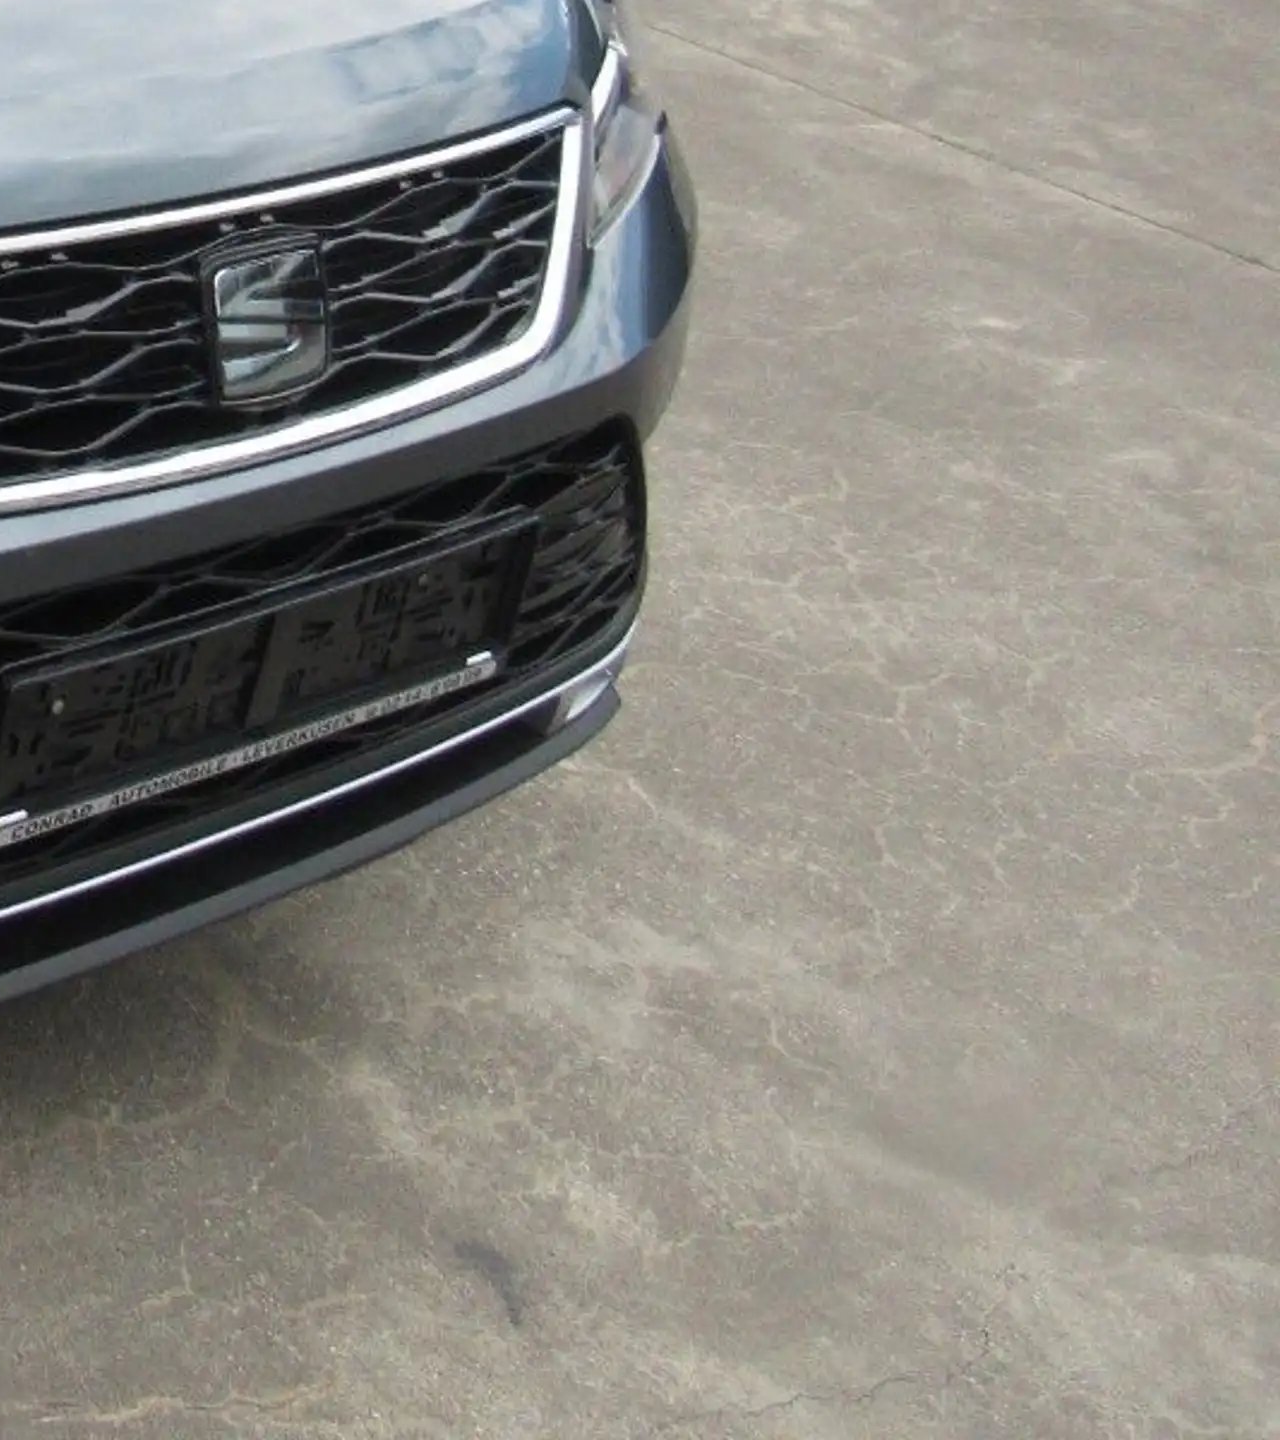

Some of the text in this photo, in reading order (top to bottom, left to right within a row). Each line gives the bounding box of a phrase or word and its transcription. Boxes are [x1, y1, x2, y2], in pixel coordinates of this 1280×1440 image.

[10, 802, 93, 842] CONRAD
[109, 757, 228, 808] AUTOMOBILE
[242, 710, 357, 764] LEVERKUSEN
